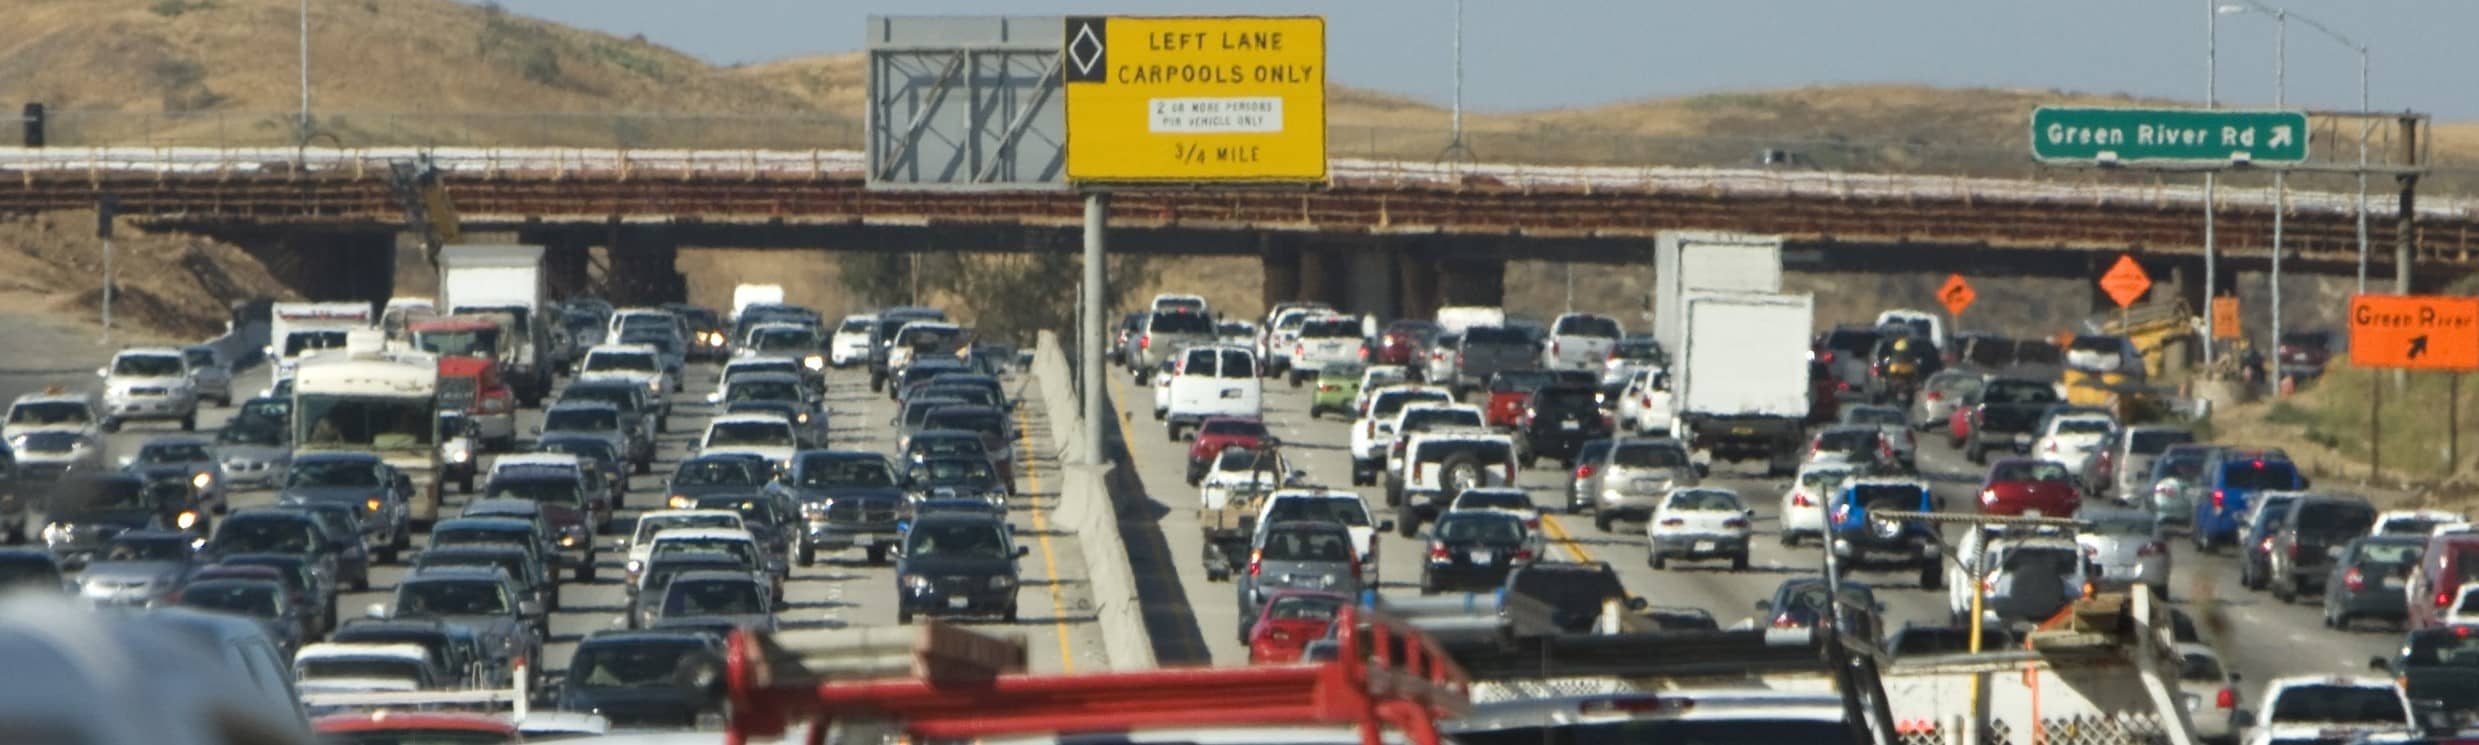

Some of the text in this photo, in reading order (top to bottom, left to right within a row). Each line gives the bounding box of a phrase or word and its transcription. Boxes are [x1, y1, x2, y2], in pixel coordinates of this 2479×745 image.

[1150, 32, 1283, 51] LEFT LANE
[1118, 65, 1313, 84] CARPOOLS ONLY
[1157, 102, 1165, 114] 2
[1192, 102, 1219, 113] MORE
[1226, 102, 1272, 113] PERSONS
[1190, 116, 1231, 127] VEHICLE
[1238, 116, 1263, 127] ONLY
[2047, 123, 2254, 147] Green River Rd
[1175, 142, 1259, 165] 3/4 MILE
[2356, 305, 2471, 327] Green River
